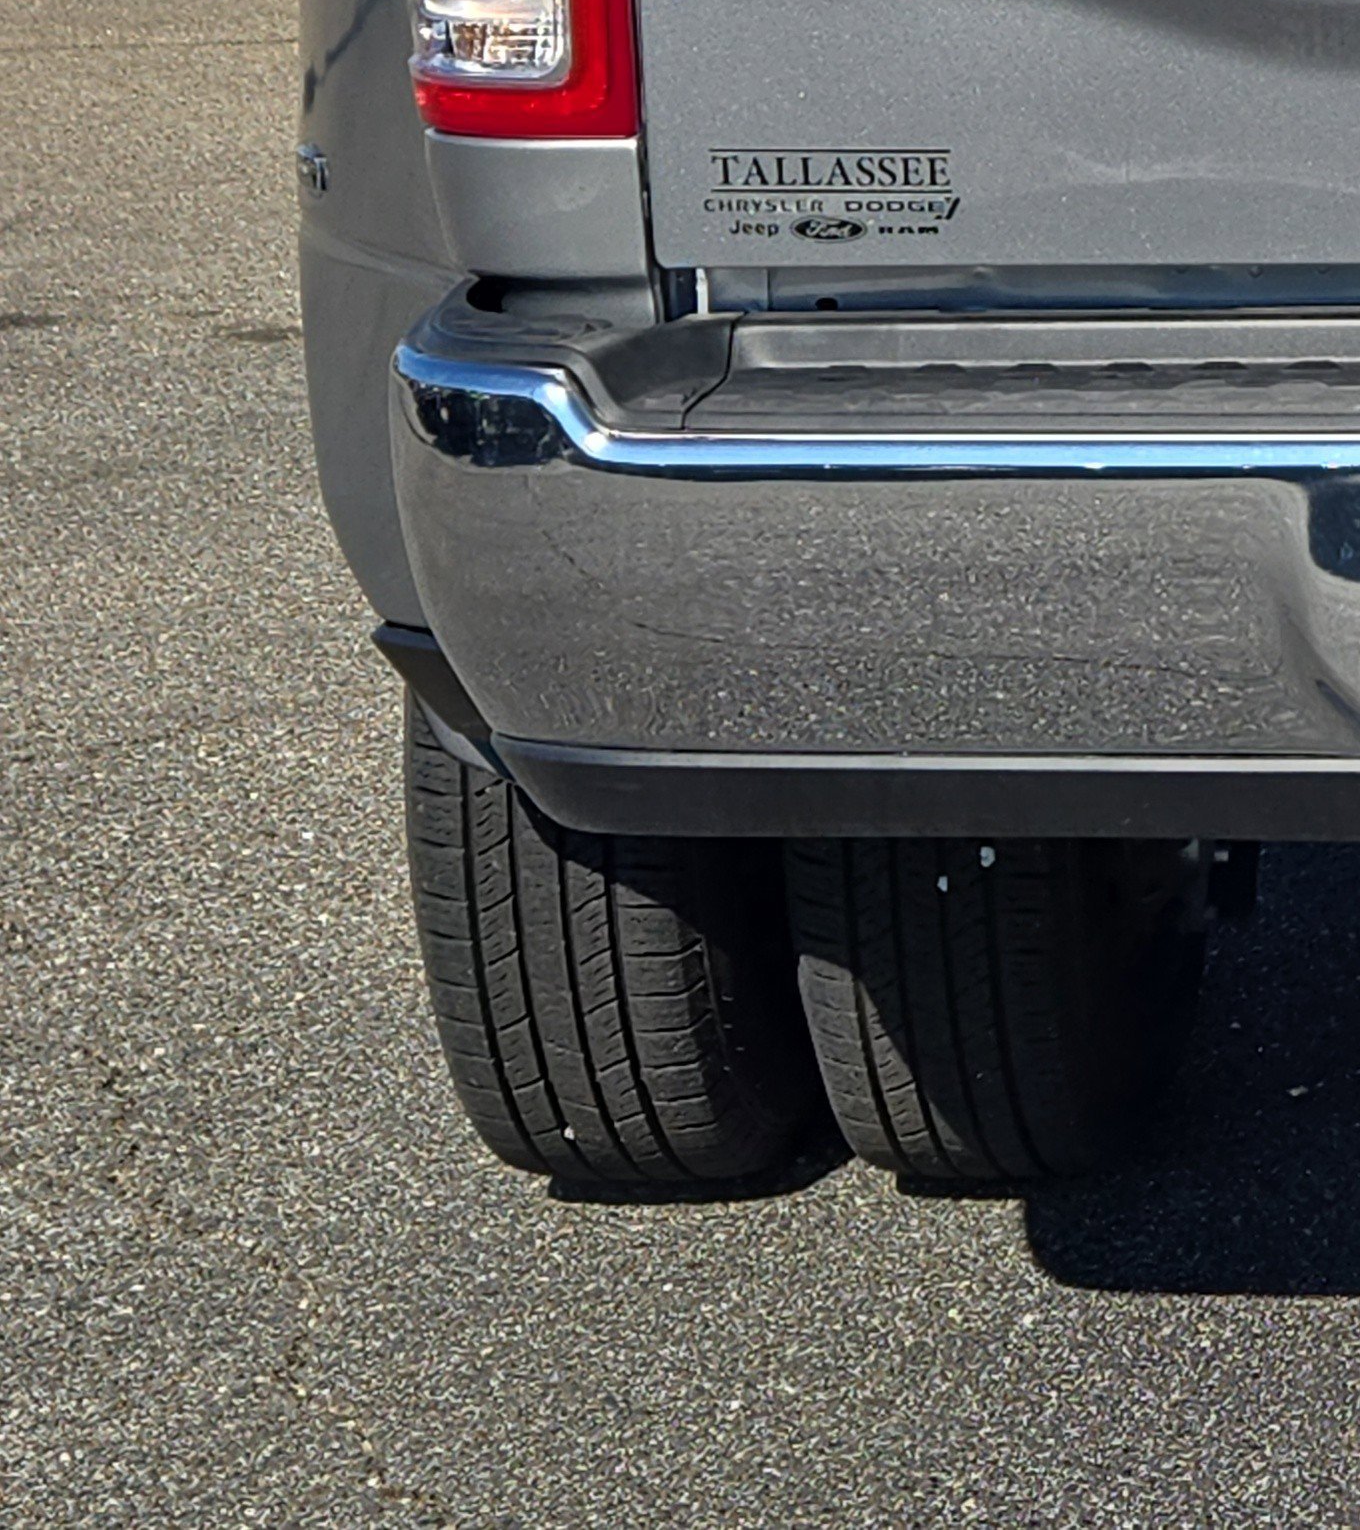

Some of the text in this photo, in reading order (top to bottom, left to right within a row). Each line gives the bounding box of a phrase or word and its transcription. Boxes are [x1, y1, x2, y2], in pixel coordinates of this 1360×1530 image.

[710, 155, 952, 187] TALLASSEE
[703, 198, 945, 213] CHRYSLER DODGE
[728, 220, 780, 238] Jeep
